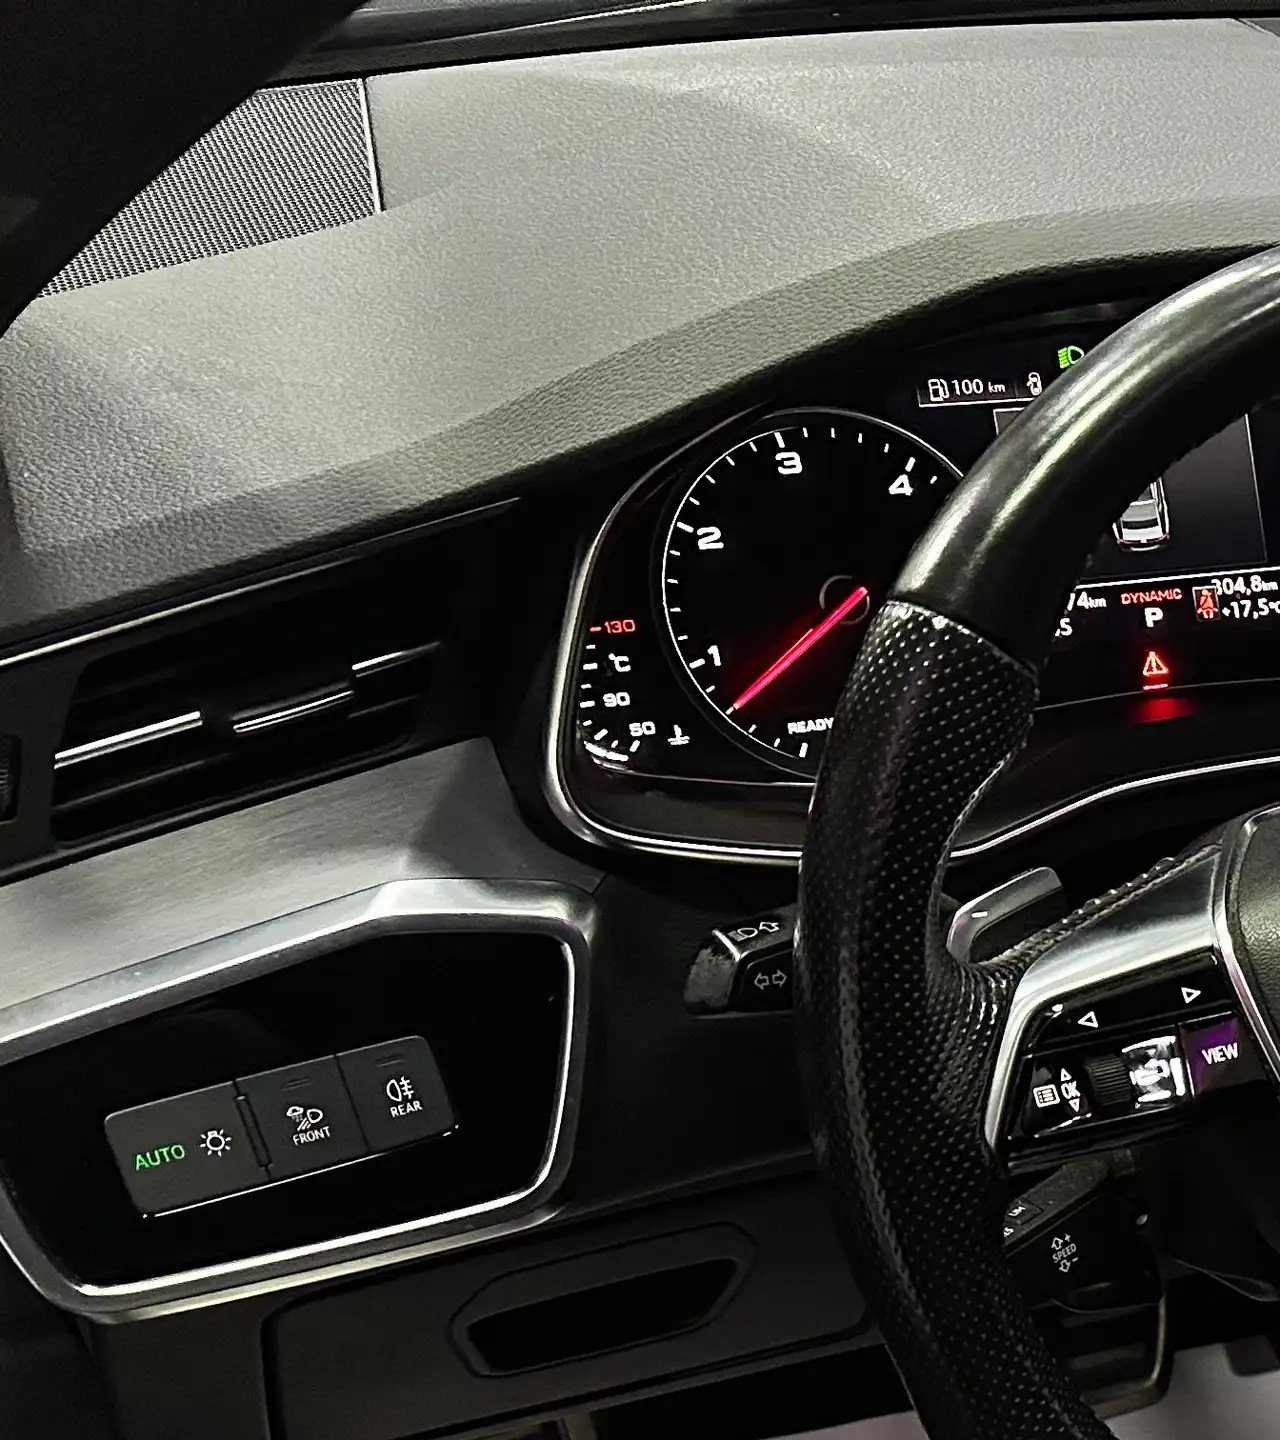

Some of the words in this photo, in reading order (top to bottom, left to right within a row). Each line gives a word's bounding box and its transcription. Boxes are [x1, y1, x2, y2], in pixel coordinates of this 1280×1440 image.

[952, 378, 984, 396] 100
[988, 380, 1006, 395] km
[777, 451, 803, 475] 3
[888, 474, 914, 497] 4
[696, 527, 724, 550] 2
[1121, 588, 1183, 605] DYNAMIC
[604, 619, 636, 634] 130
[1144, 607, 1164, 628] P
[706, 645, 721, 667] 1
[602, 692, 631, 708] 90
[787, 716, 835, 734] READY
[1201, 1042, 1239, 1065] VIEW
[1061, 1081, 1081, 1099] OK
[388, 1100, 423, 1119] REAR
[291, 1125, 332, 1146] FRONT
[134, 1143, 186, 1171] AUTO
[1051, 1243, 1077, 1263] SPEED
